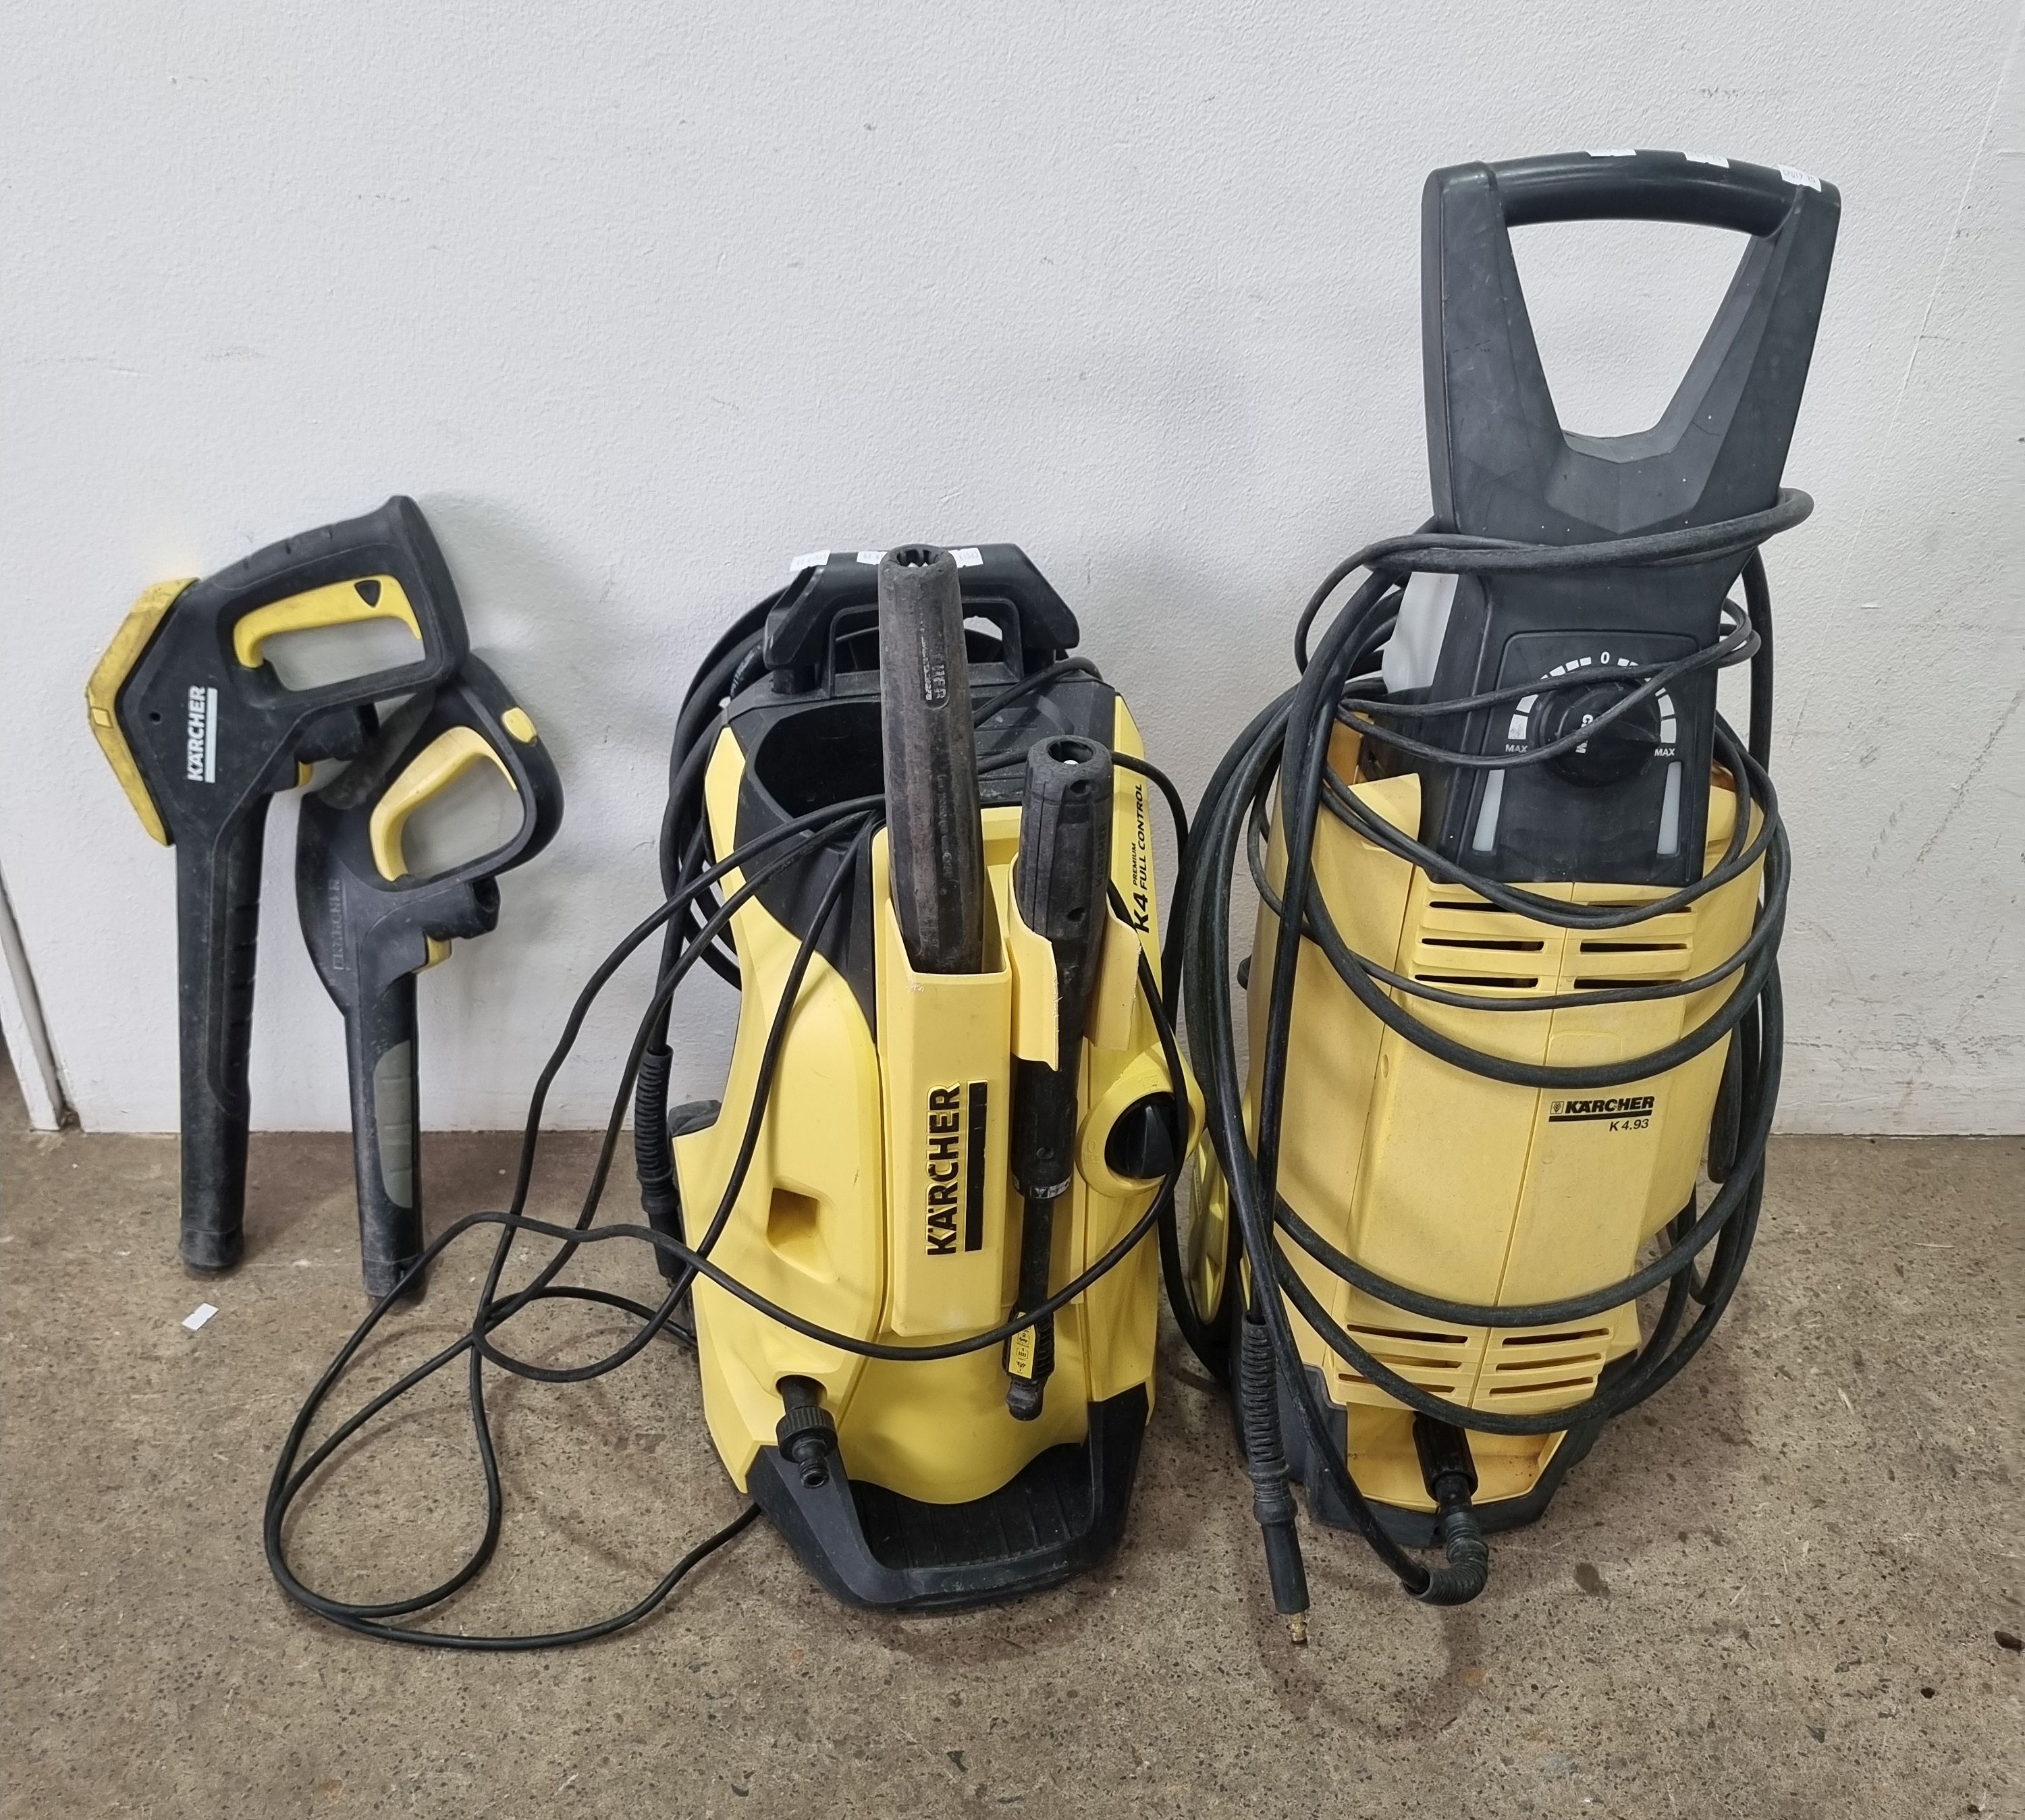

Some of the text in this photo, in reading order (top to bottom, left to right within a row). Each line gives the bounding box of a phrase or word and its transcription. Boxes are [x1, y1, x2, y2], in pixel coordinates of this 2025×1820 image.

[1600, 651, 1611, 664] 0
[1505, 744, 1528, 753] MAX
[1654, 748, 1675, 756] MAX
[1135, 783, 1146, 851] CONTROL
[1139, 855, 1148, 891] FULL
[1565, 1096, 1655, 1114] KÄRCHER
[1609, 1118, 1649, 1132] K 4.93
[926, 1081, 961, 1256] KÄRCHER
